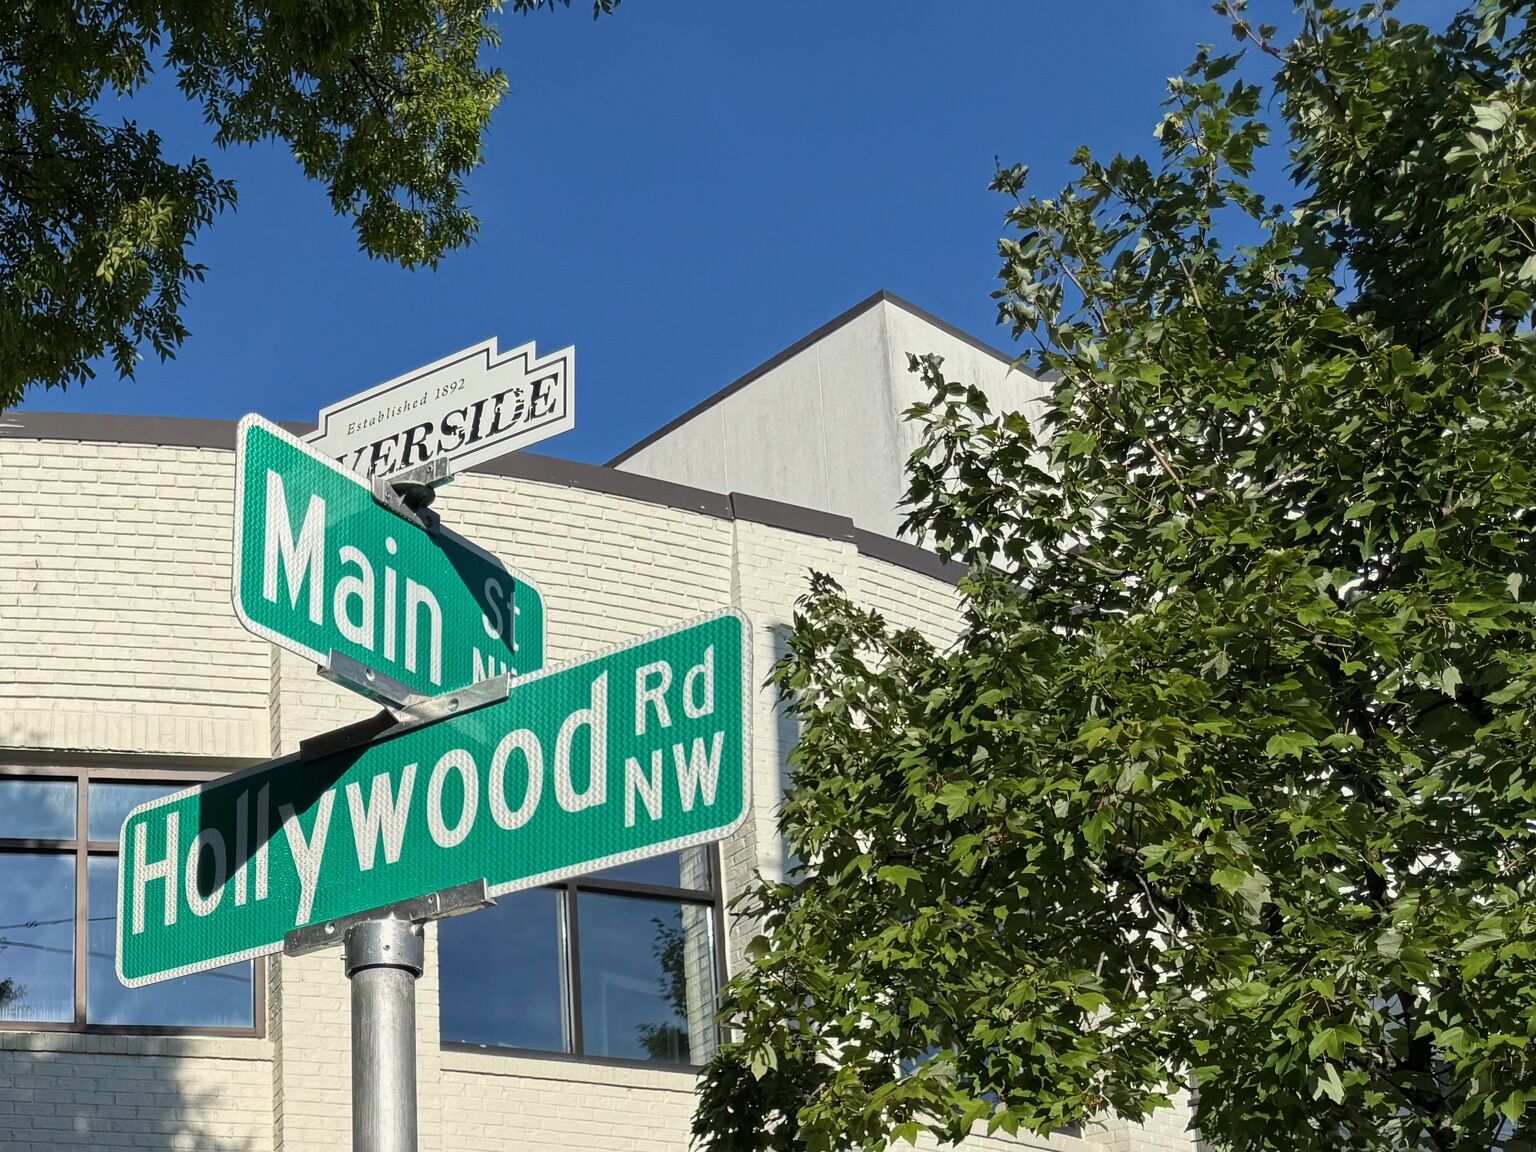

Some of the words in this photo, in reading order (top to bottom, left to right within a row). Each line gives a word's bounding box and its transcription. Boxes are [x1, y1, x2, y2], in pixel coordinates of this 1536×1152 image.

[336, 371, 559, 478] VERSIDE
[346, 392, 428, 436] Established
[434, 377, 466, 401] 1892
[262, 468, 442, 687] Main
[482, 577, 521, 652] St
[472, 646, 517, 684] N
[130, 668, 609, 935] Hollywood
[634, 644, 715, 735] Rd
[624, 731, 724, 828] NW
